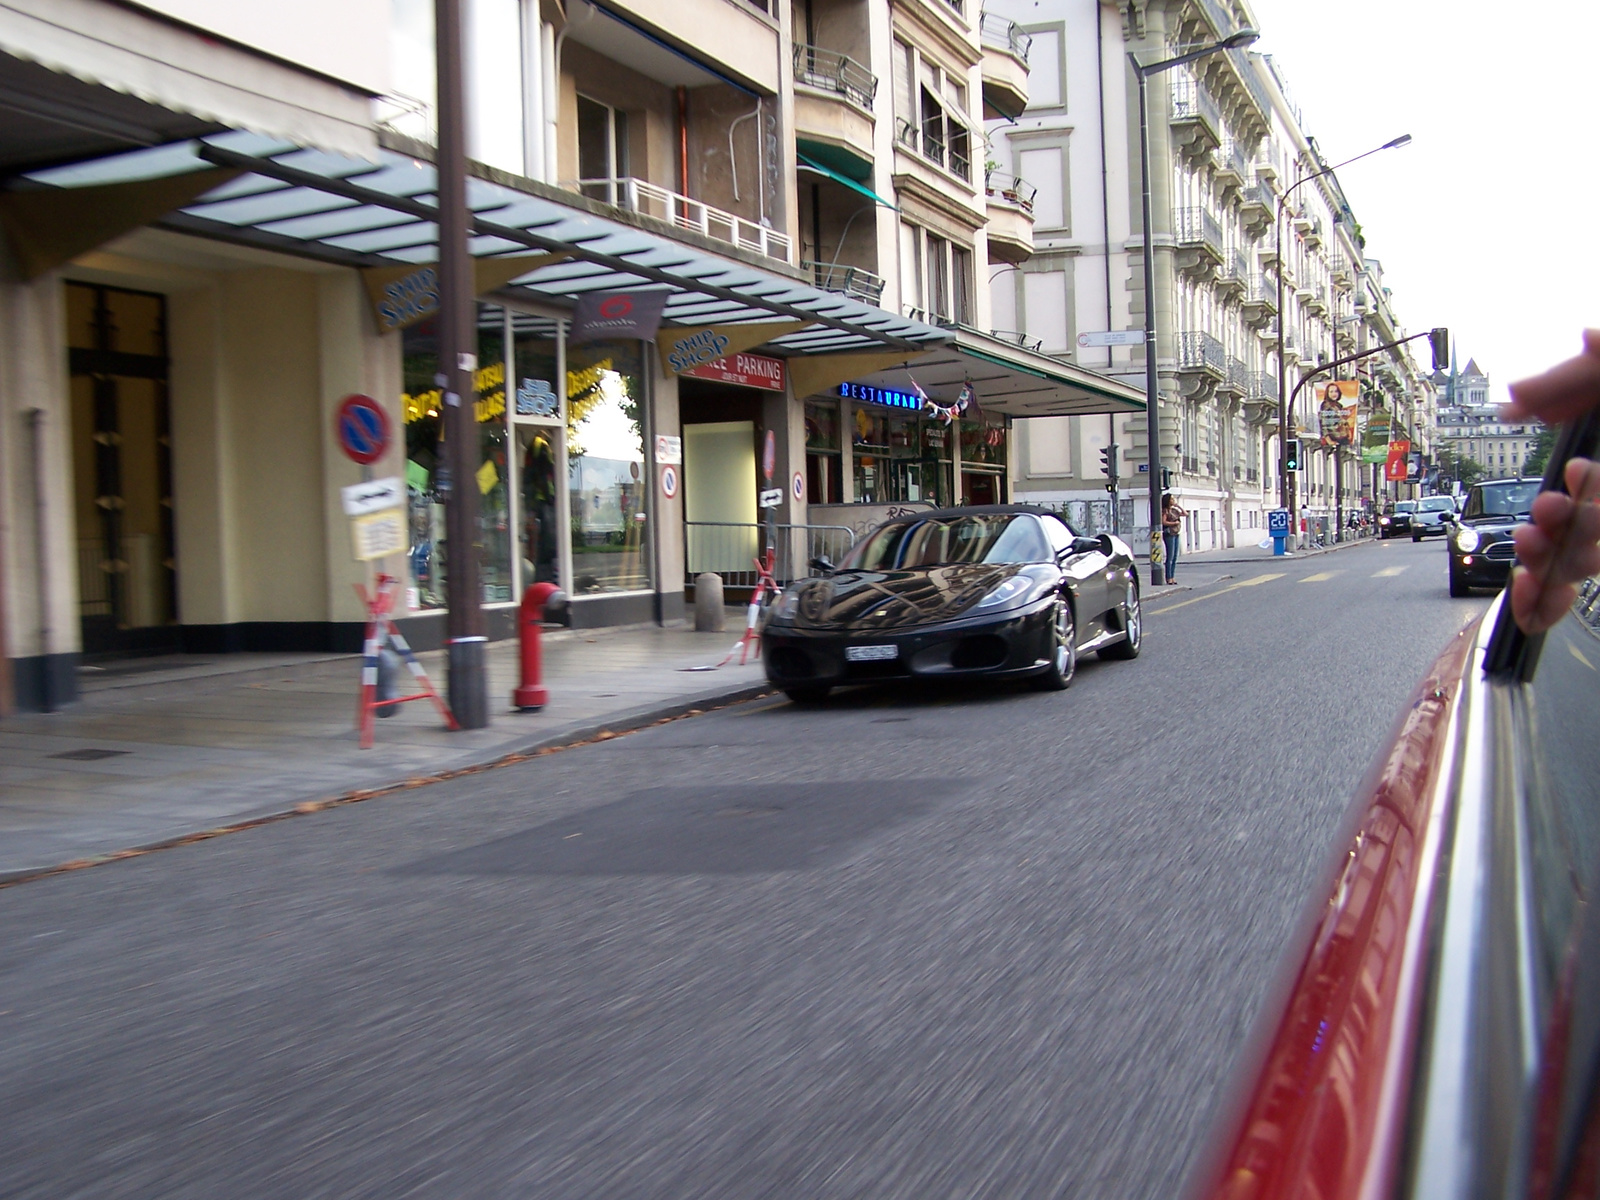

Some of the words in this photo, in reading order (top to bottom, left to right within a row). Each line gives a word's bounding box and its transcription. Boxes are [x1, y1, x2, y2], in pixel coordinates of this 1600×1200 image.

[378, 280, 440, 328] SHO
[668, 334, 729, 373] SHOP
[674, 329, 715, 353] SHIP
[736, 355, 781, 380] PARKING
[516, 388, 557, 414] SHOP
[841, 382, 922, 411] RESTAURANT
[1271, 513, 1286, 527] 20
